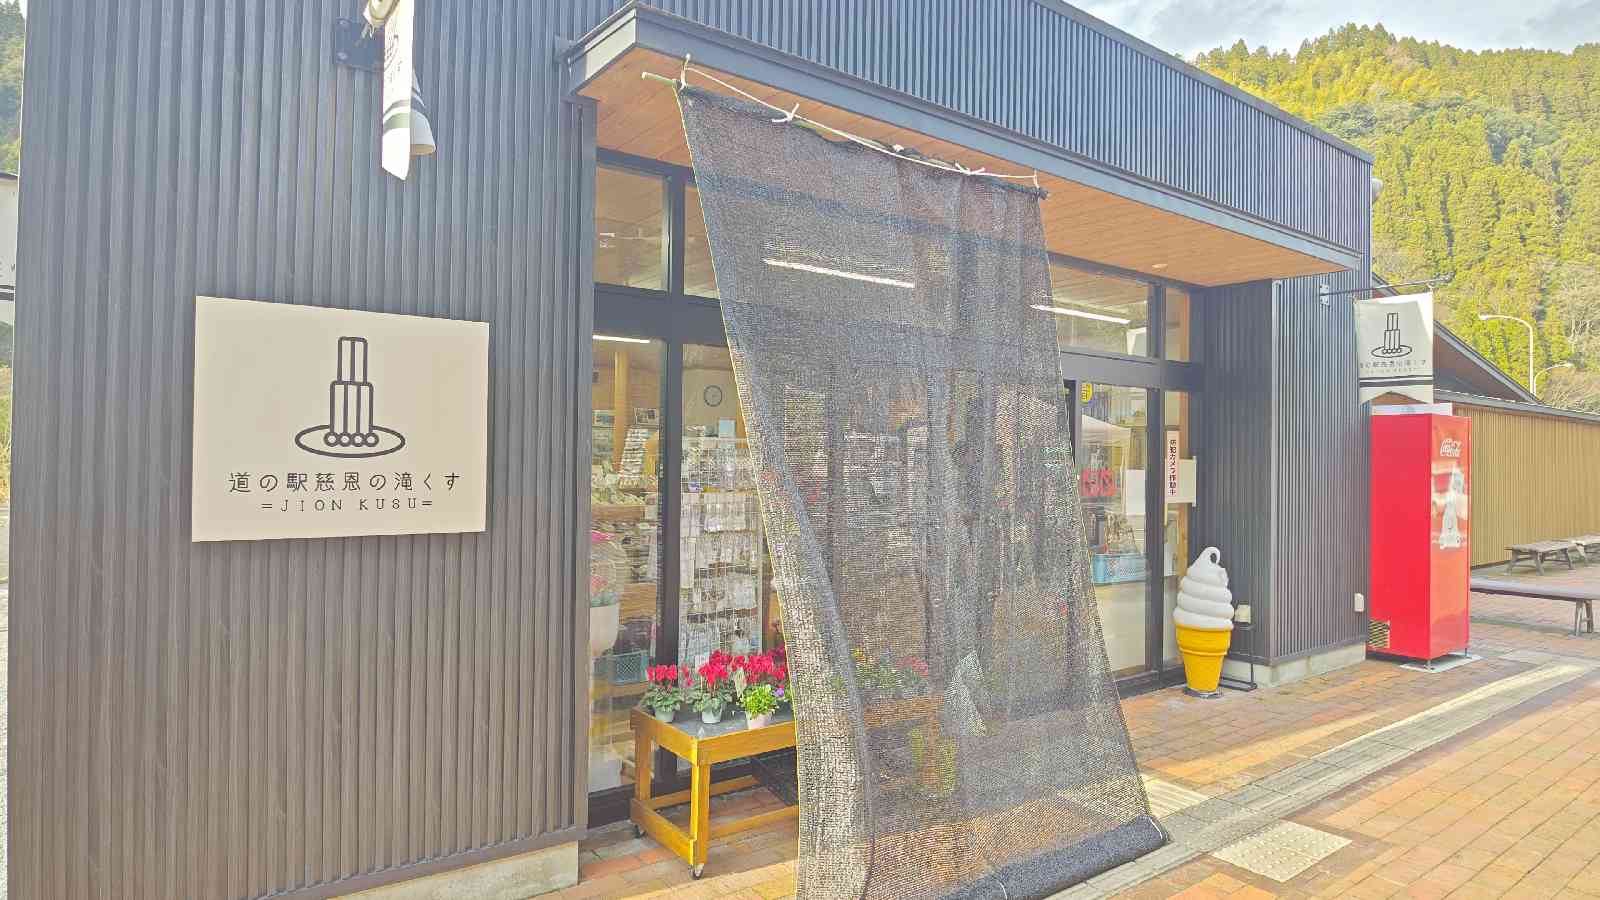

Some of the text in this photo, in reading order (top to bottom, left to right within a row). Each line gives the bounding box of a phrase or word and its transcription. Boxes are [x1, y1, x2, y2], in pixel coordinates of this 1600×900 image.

[228, 471, 461, 493] 道の駅慈恩の滝くす
